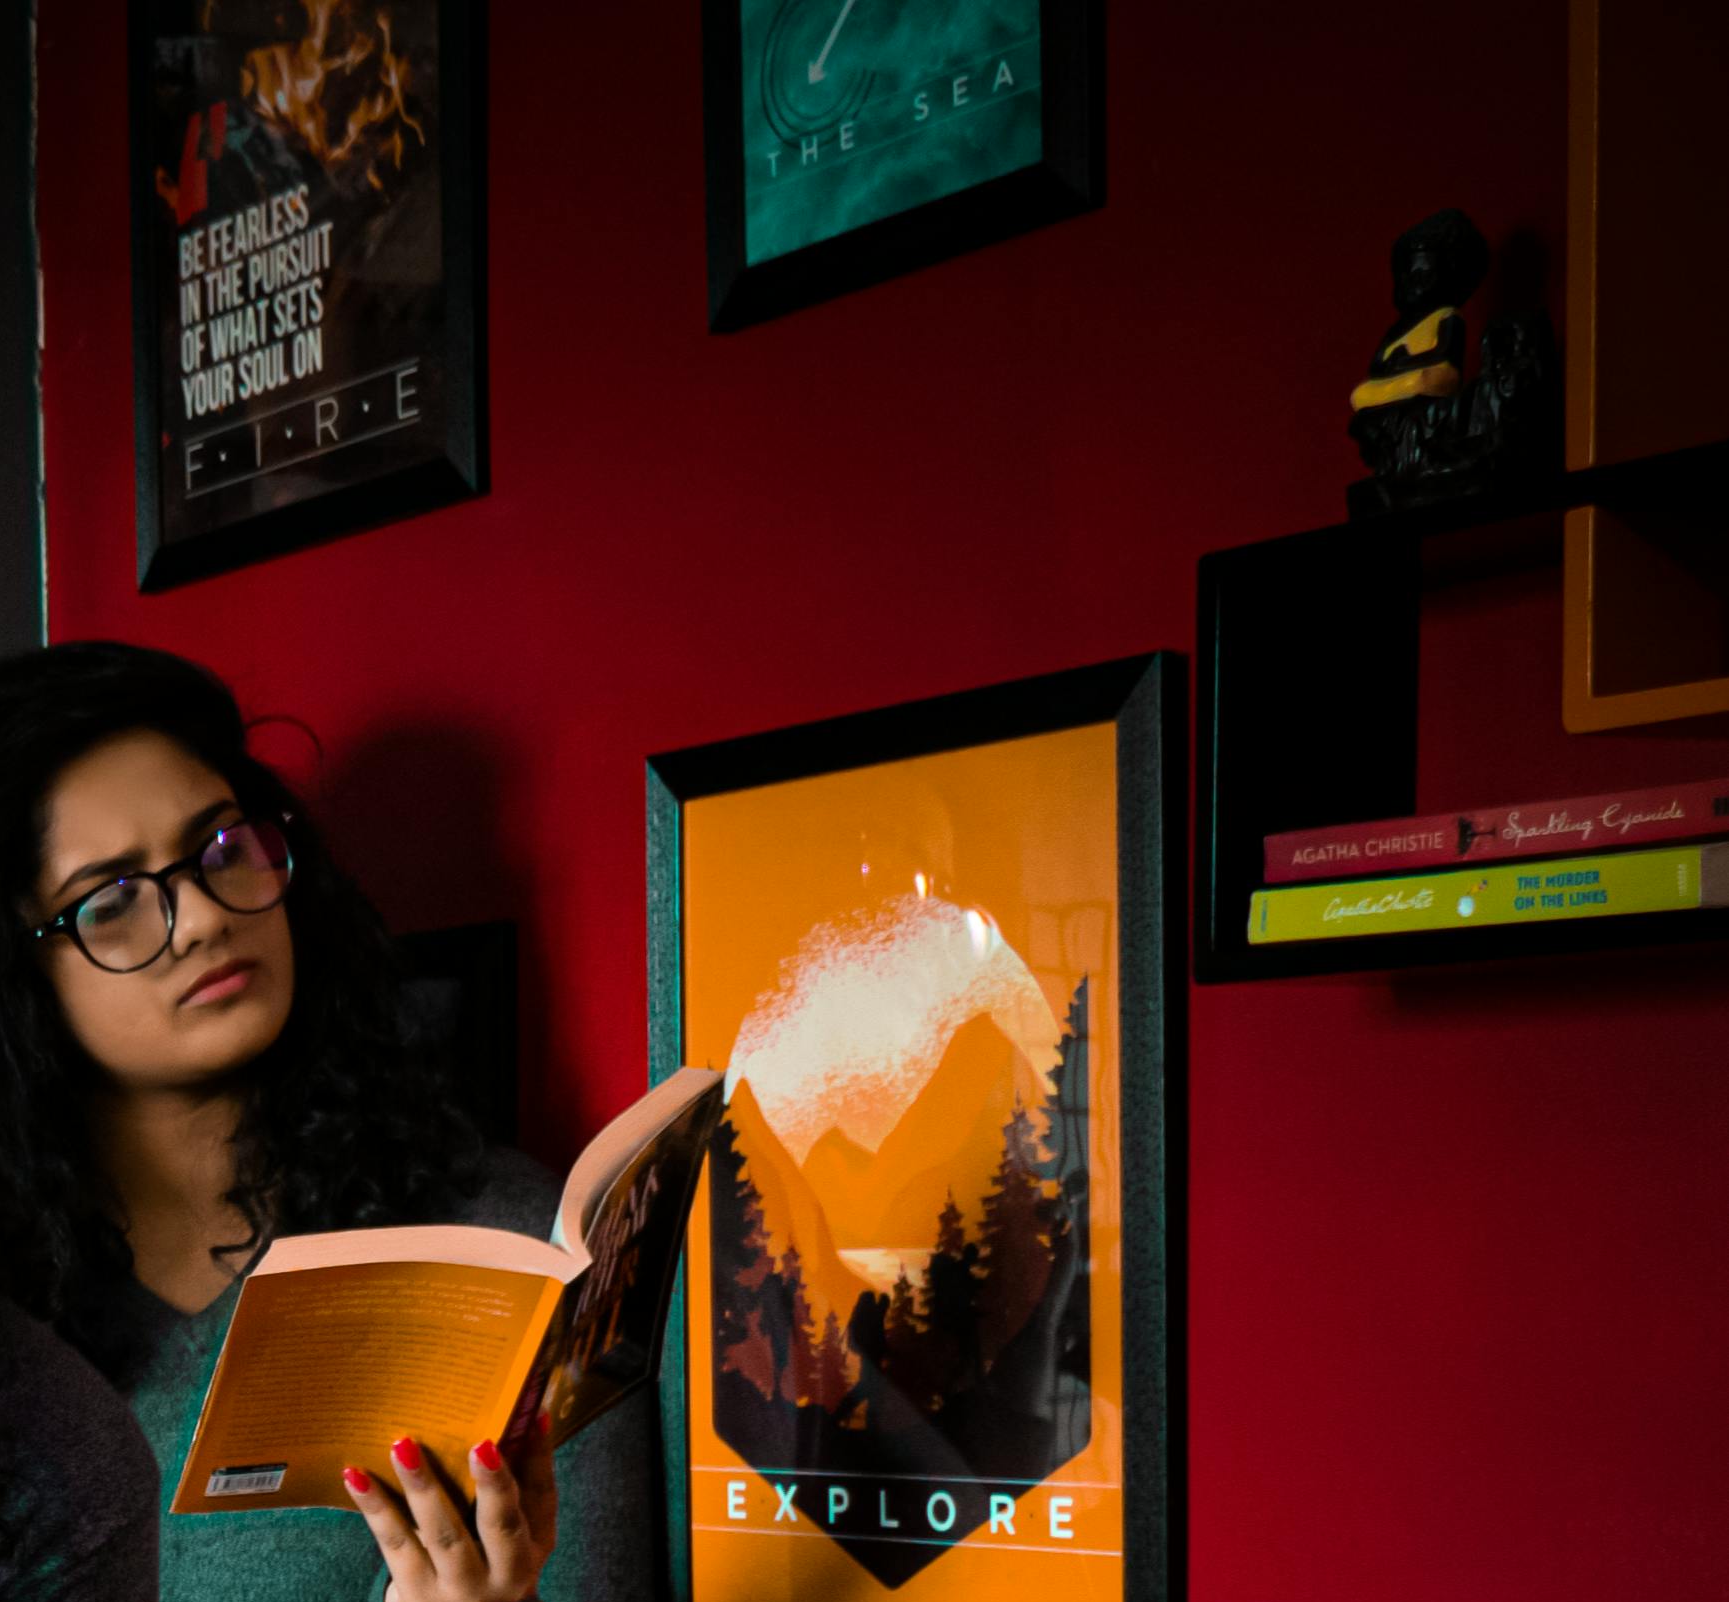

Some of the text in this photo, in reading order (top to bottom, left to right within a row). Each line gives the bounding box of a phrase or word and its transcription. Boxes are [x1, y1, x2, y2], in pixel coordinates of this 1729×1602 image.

[766, 60, 1014, 177] THE SEA
[178, 183, 310, 278] BE FEARLESS
[180, 221, 333, 327] IN THE PURSUIT
[181, 278, 324, 373] OF WHAT SETS
[181, 327, 323, 420] YOUR SOUL ON
[1291, 832, 1443, 865] AGATHA CHRISTIE
[1502, 811, 1592, 840] Sparkling
[1602, 800, 1684, 833] Cyanide
[1516, 870, 1600, 891] THE MURDER
[1541, 893, 1564, 908] THE
[726, 1481, 1074, 1539] EXPLORE
